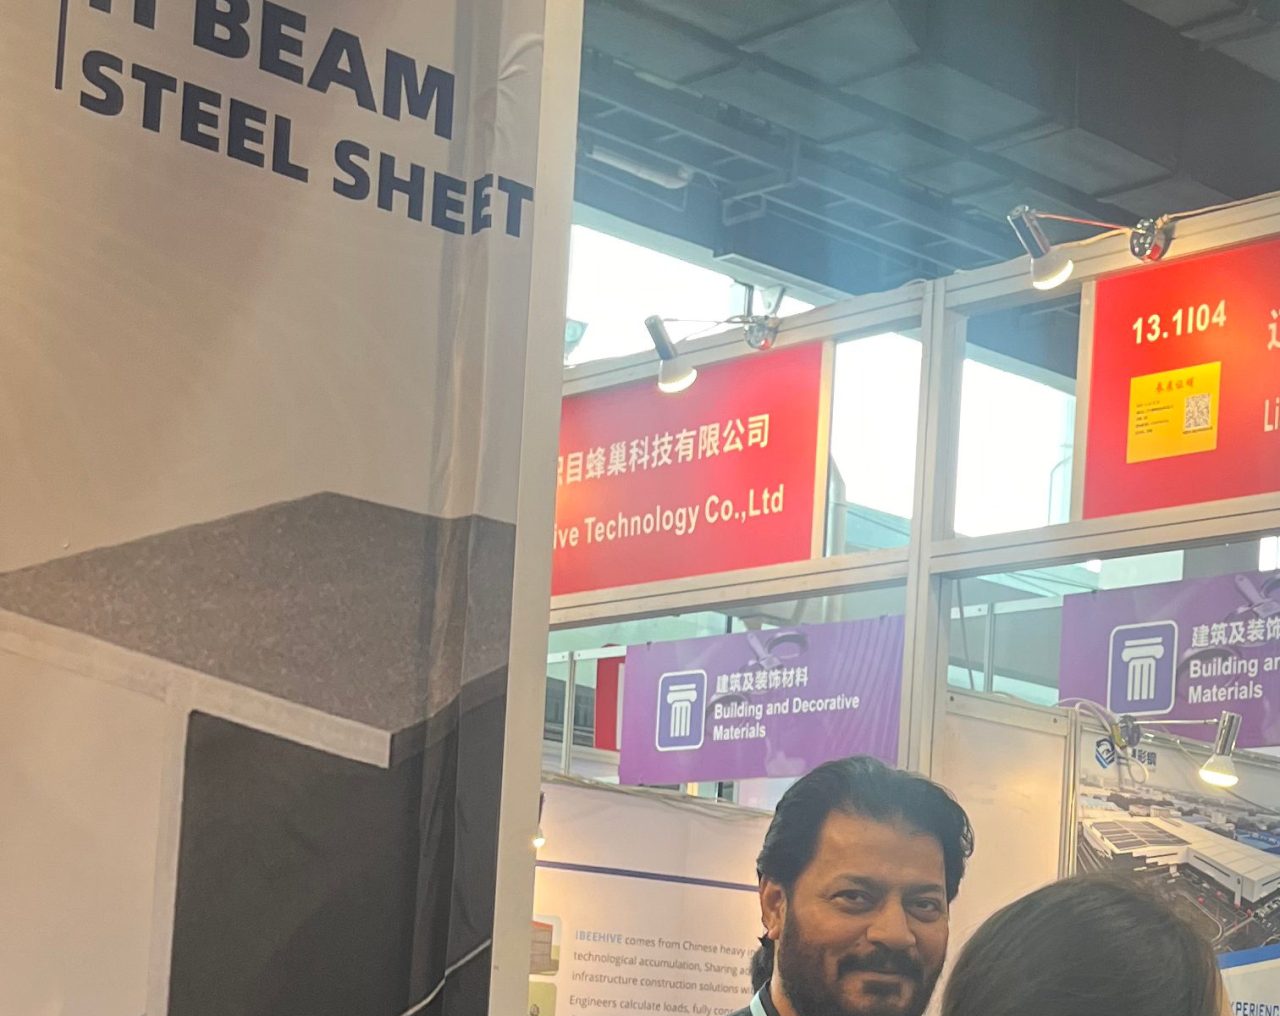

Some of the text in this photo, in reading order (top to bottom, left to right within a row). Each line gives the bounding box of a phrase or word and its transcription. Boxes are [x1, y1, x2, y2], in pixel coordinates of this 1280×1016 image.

[193, 0, 455, 141] BEAM
[79, 50, 534, 238] STEEL SHEET
[553, 484, 785, 550] ive Technology Co.,Ltd
[1189, 652, 1259, 679] Building
[716, 666, 809, 694] 建筑及装饰材料
[1188, 680, 1263, 705] Materials
[714, 693, 860, 720] Building and Decorative
[713, 722, 766, 741] Materials
[625, 936, 656, 947] comes
[658, 937, 680, 950] from
[682, 940, 717, 954] Chinese
[720, 944, 745, 958] heavy
[573, 952, 637, 967] technological
[704, 961, 737, 977] Sharing
[572, 970, 638, 985] infrastructure
[640, 977, 697, 990] construction
[699, 981, 739, 994] solutions
[569, 994, 617, 1009] Engineers
[620, 999, 661, 1011] calculate
[693, 1003, 712, 1016] fully
